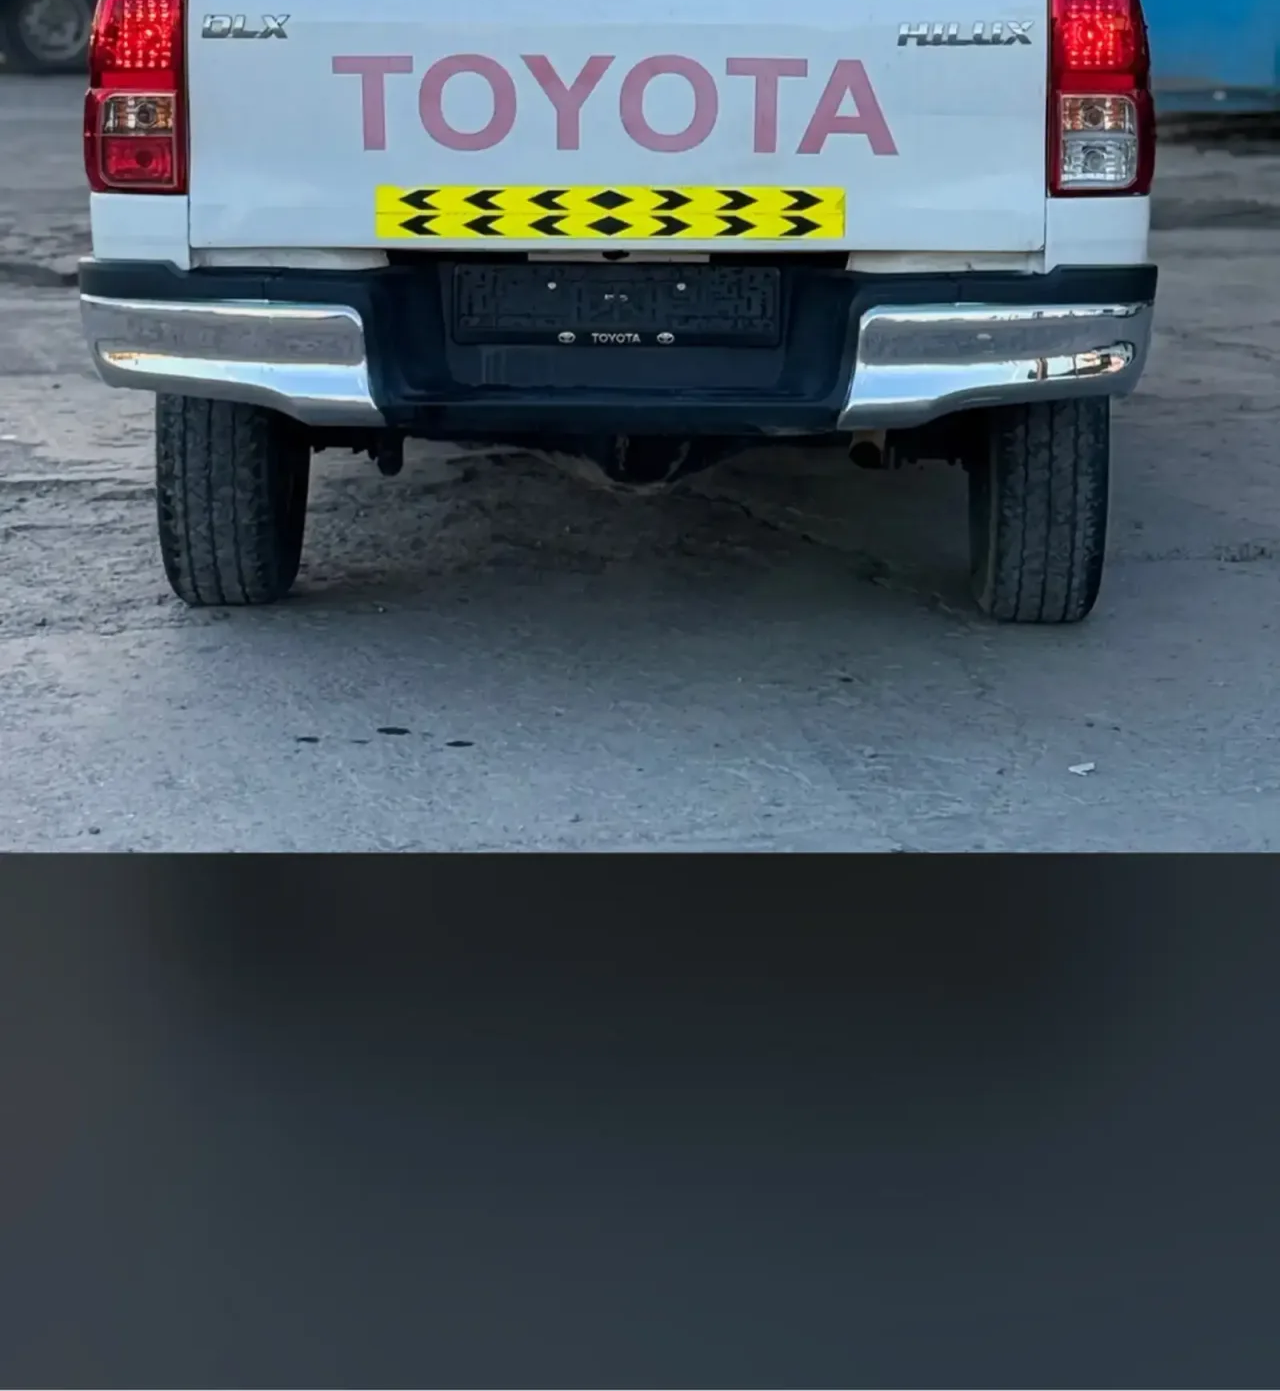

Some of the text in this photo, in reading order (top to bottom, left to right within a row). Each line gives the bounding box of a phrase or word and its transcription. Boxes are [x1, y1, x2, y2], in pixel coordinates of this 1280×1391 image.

[202, 14, 291, 39] DLX
[897, 20, 1035, 46] HILUX
[332, 54, 899, 156] TOYOTA
[591, 332, 641, 344] TOYOTA
